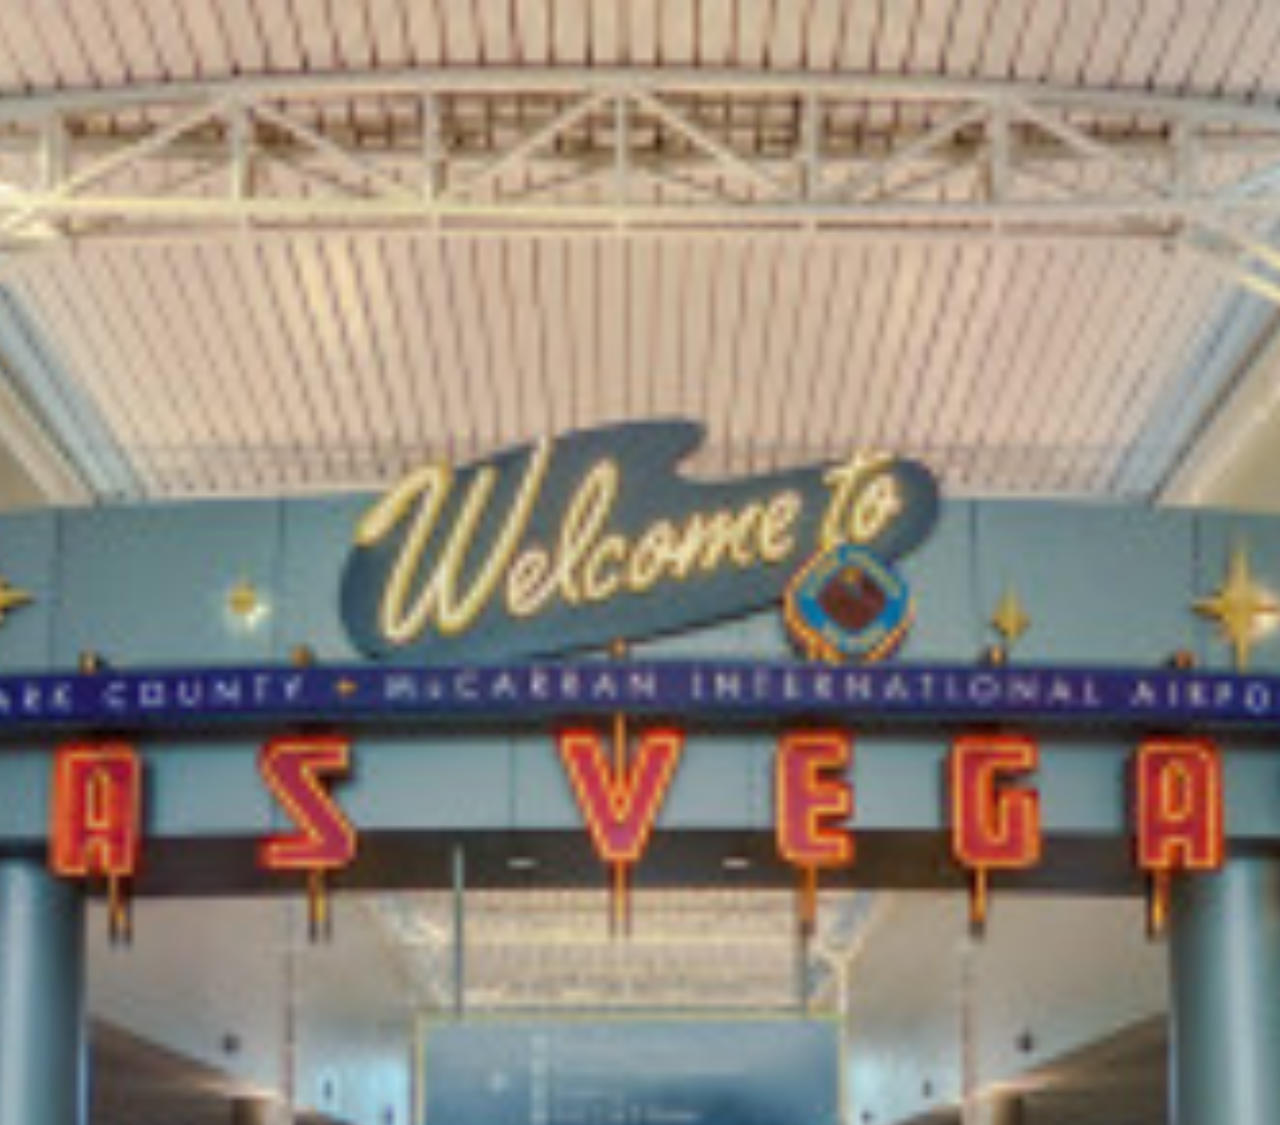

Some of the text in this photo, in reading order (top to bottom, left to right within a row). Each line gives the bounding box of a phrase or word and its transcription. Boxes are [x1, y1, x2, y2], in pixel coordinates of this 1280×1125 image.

[354, 436, 801, 643] Welcome
[819, 447, 904, 551] to
[102, 672, 307, 709] COUNTY
[689, 670, 1103, 708] INTERNATIONAL
